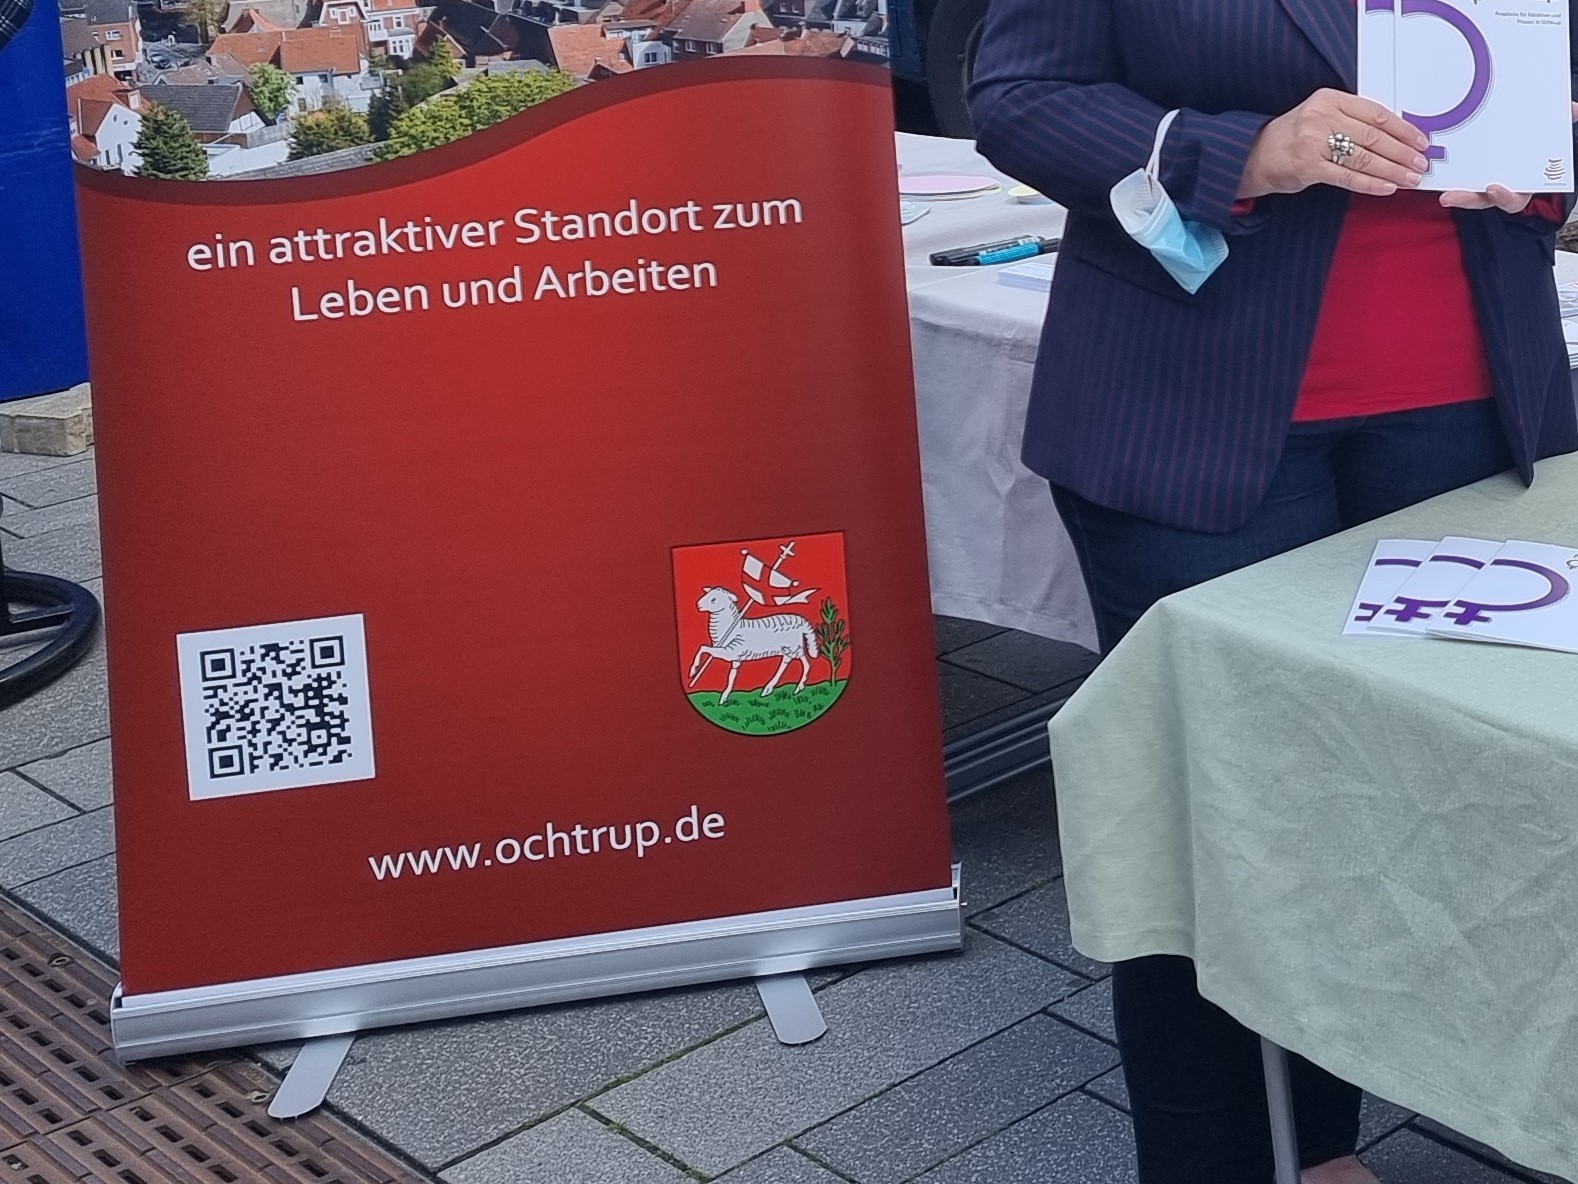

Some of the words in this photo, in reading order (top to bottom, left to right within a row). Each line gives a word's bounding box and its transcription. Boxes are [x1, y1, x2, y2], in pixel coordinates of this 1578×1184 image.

[187, 234, 255, 271] ein
[268, 217, 504, 264] attraktiver
[514, 198, 703, 244] Standort
[713, 196, 802, 230] zum
[291, 279, 430, 321] Leben
[442, 266, 524, 309] und
[533, 258, 717, 302] Arbeiten
[367, 804, 727, 880] www.ochtrup.de
